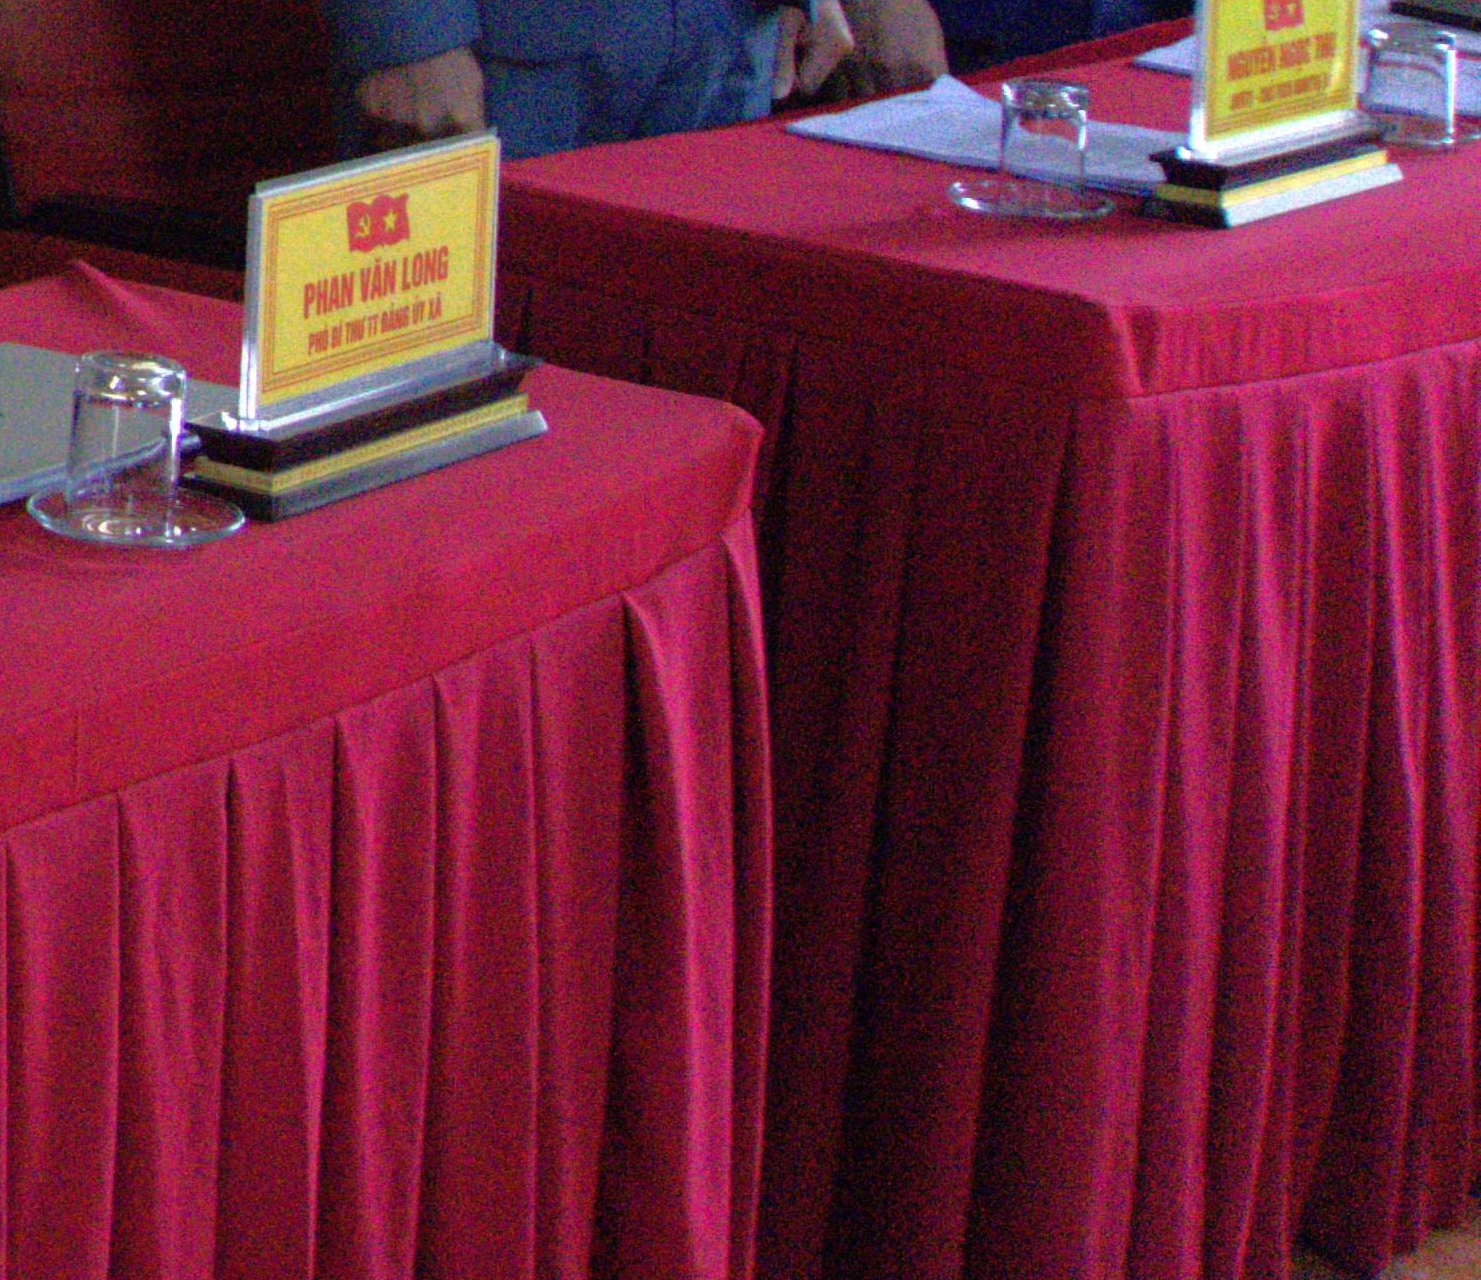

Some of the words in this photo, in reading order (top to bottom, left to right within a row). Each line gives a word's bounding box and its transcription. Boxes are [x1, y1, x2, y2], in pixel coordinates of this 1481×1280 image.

[304, 271, 354, 319] PHAN
[360, 257, 396, 302] VĂN
[402, 246, 448, 291] LONG
